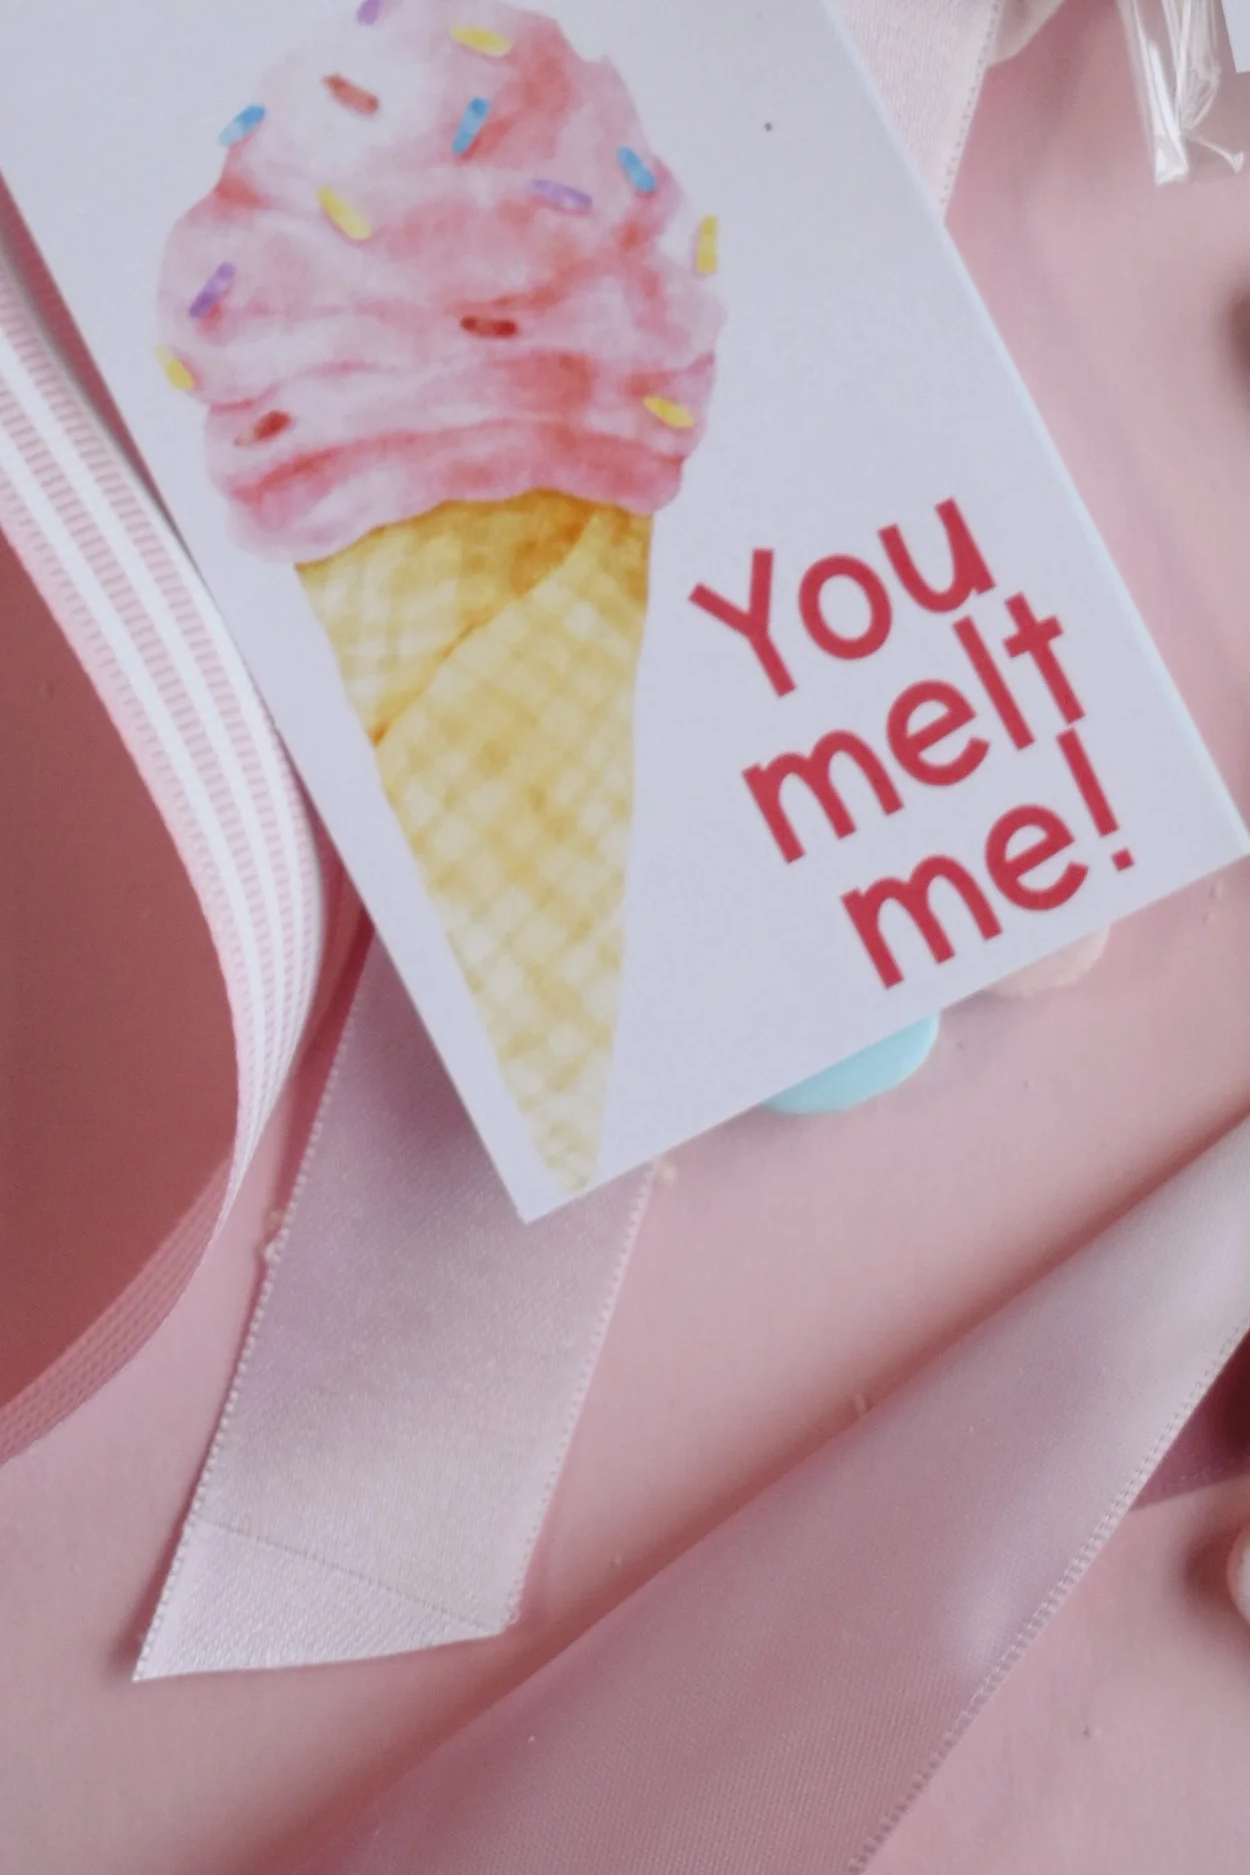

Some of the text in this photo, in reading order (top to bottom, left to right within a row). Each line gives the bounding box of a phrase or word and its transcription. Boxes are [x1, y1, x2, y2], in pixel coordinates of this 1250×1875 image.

[689, 498, 996, 697] You
[742, 592, 1085, 863] melt
[841, 727, 1135, 988] me!
